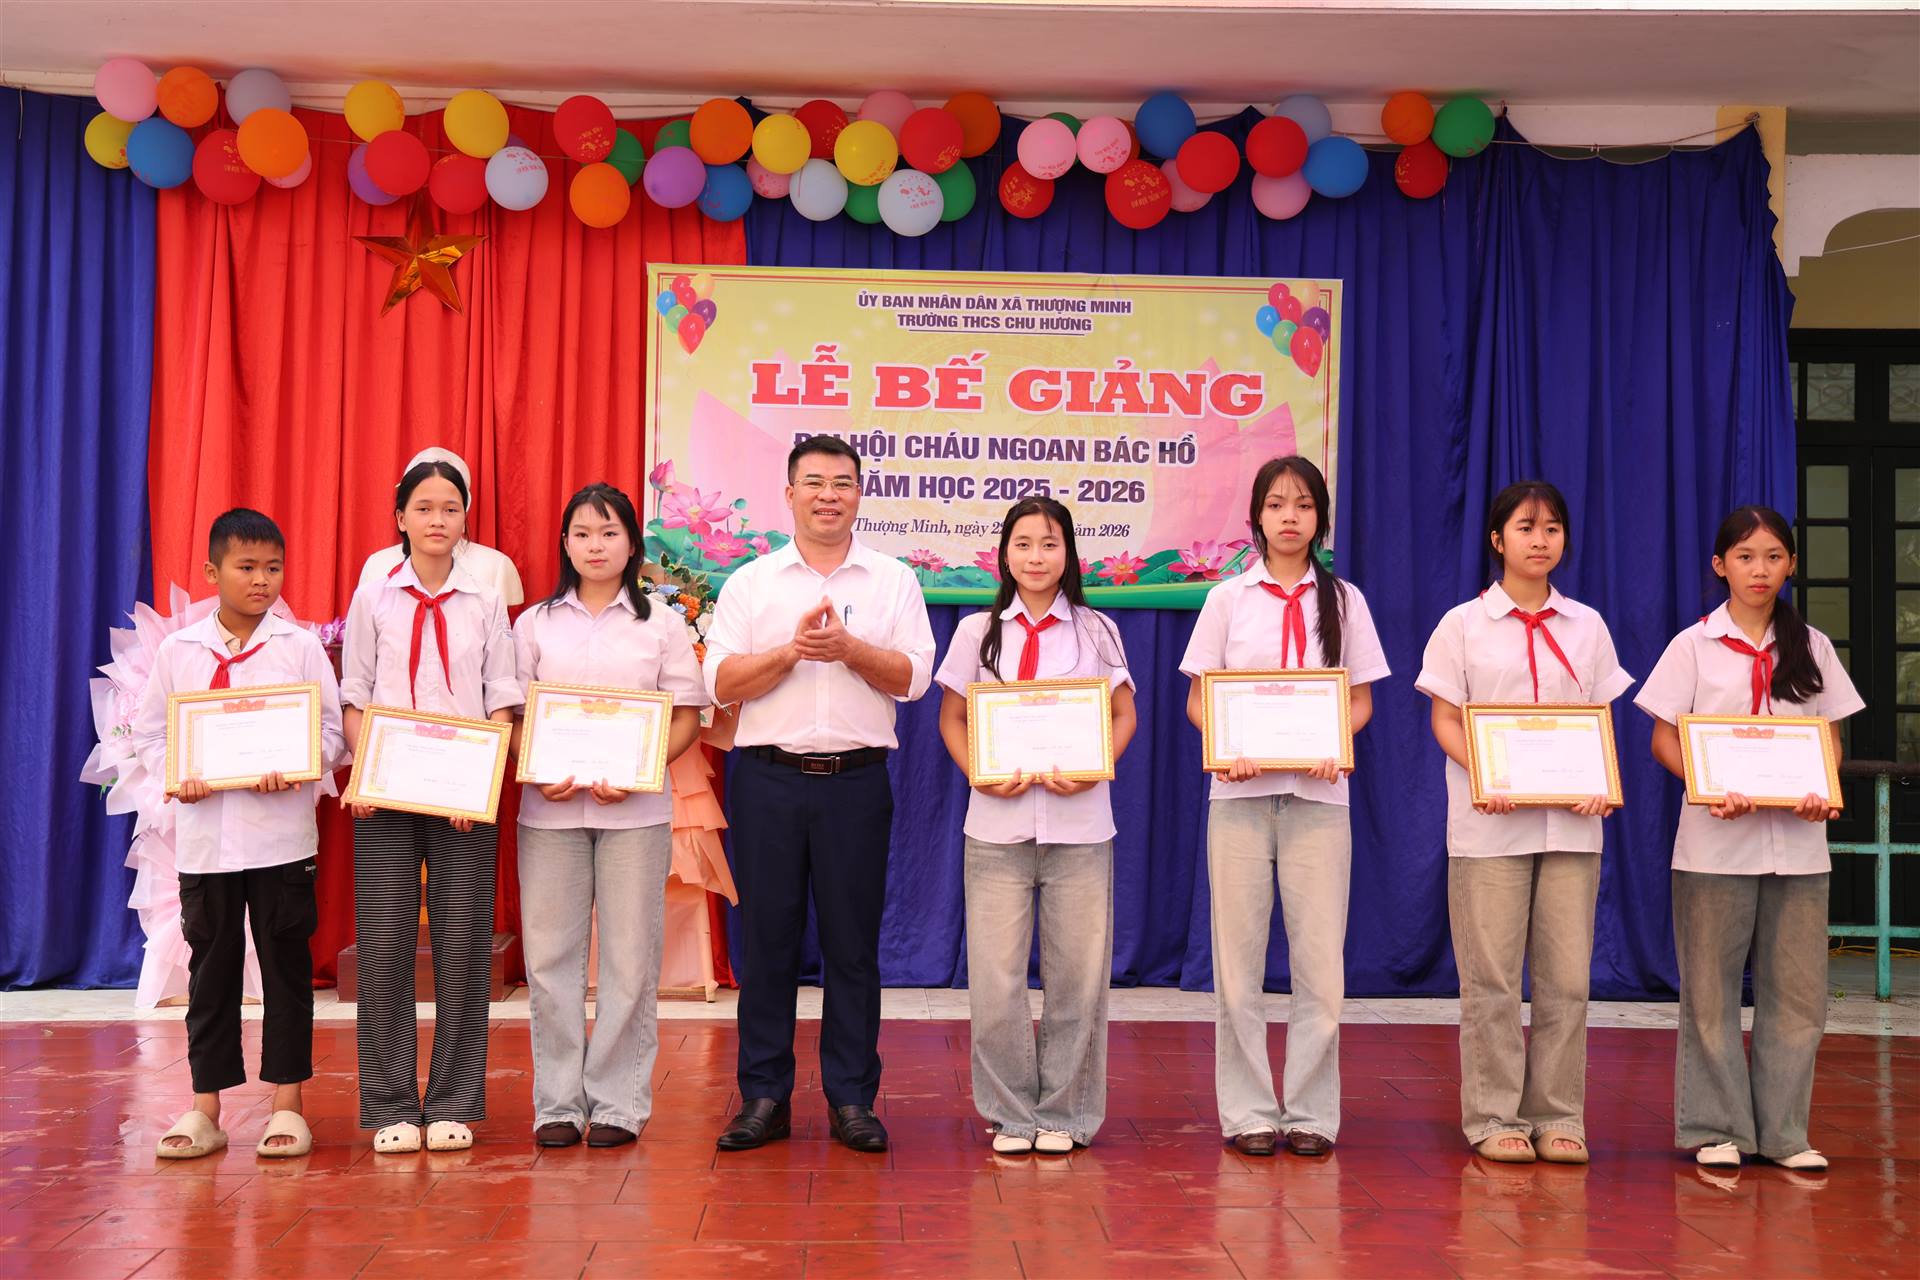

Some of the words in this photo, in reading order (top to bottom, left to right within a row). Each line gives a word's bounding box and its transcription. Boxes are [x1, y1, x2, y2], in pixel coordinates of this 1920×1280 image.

[859, 290, 878, 307] ỦY
[882, 295, 914, 308] BAN
[918, 294, 962, 309] NHÂN
[965, 295, 998, 310] DÂN
[1001, 295, 1023, 311] XÃ
[1026, 298, 1086, 315] THƯỢNG
[1090, 300, 1132, 314] MINH
[897, 312, 958, 328] TRƯỜNG
[962, 315, 1000, 329] THCS
[1005, 316, 1036, 330] CHU
[1039, 317, 1092, 331] HƯƠNG
[751, 344, 849, 406] LỄ
[874, 352, 986, 410] BẾ
[1008, 359, 1264, 418] GIẢNG
[850, 430, 896, 462] HỘI
[905, 431, 980, 460] CHÁU
[988, 437, 1085, 462] NGOAN
[1094, 435, 1150, 463] BÁC
[1158, 434, 1196, 465] HỒ
[860, 470, 910, 498] ĂM
[919, 475, 975, 504] HỌC
[983, 477, 1051, 500] 2025
[1077, 479, 1145, 503] 2026
[855, 517, 909, 536] Thượng
[910, 518, 951, 536] Minh,
[953, 520, 989, 537] ngày
[1075, 523, 1096, 537] ăm
[1098, 523, 1130, 537] 2026
